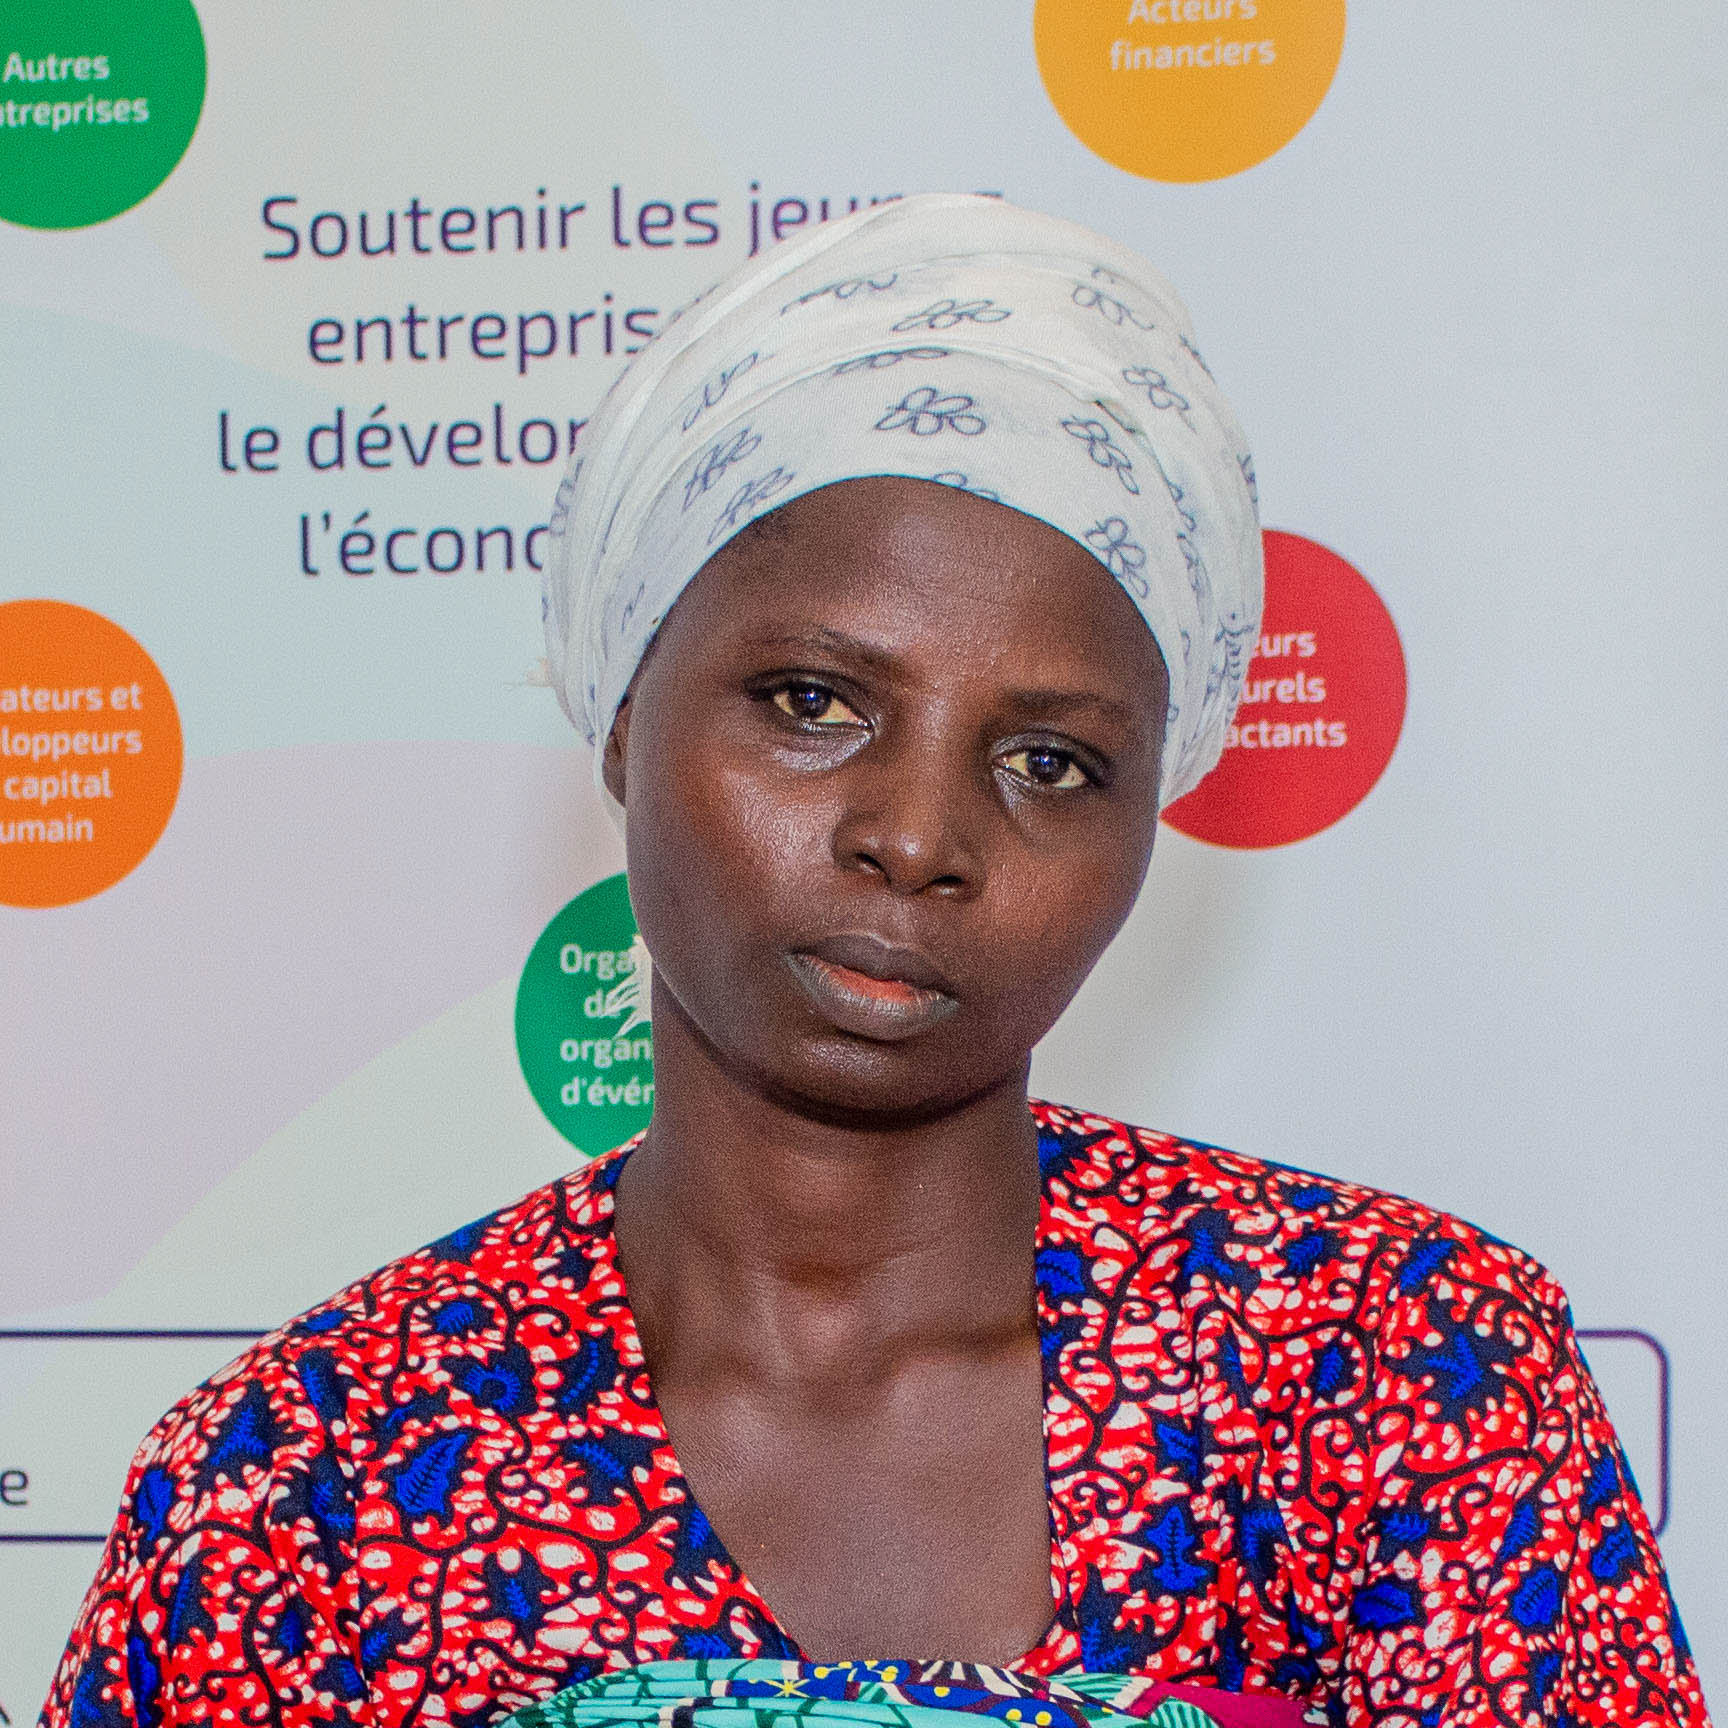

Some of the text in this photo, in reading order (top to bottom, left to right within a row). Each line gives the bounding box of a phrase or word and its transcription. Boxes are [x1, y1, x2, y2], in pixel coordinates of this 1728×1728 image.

[1, 51, 110, 86] Autres
[1110, 37, 1277, 72] financiers
[261, 187, 586, 264] Soutenir
[610, 184, 720, 250] les
[218, 410, 281, 476] le
[110, 682, 143, 714] et
[3, 767, 113, 808] capital
